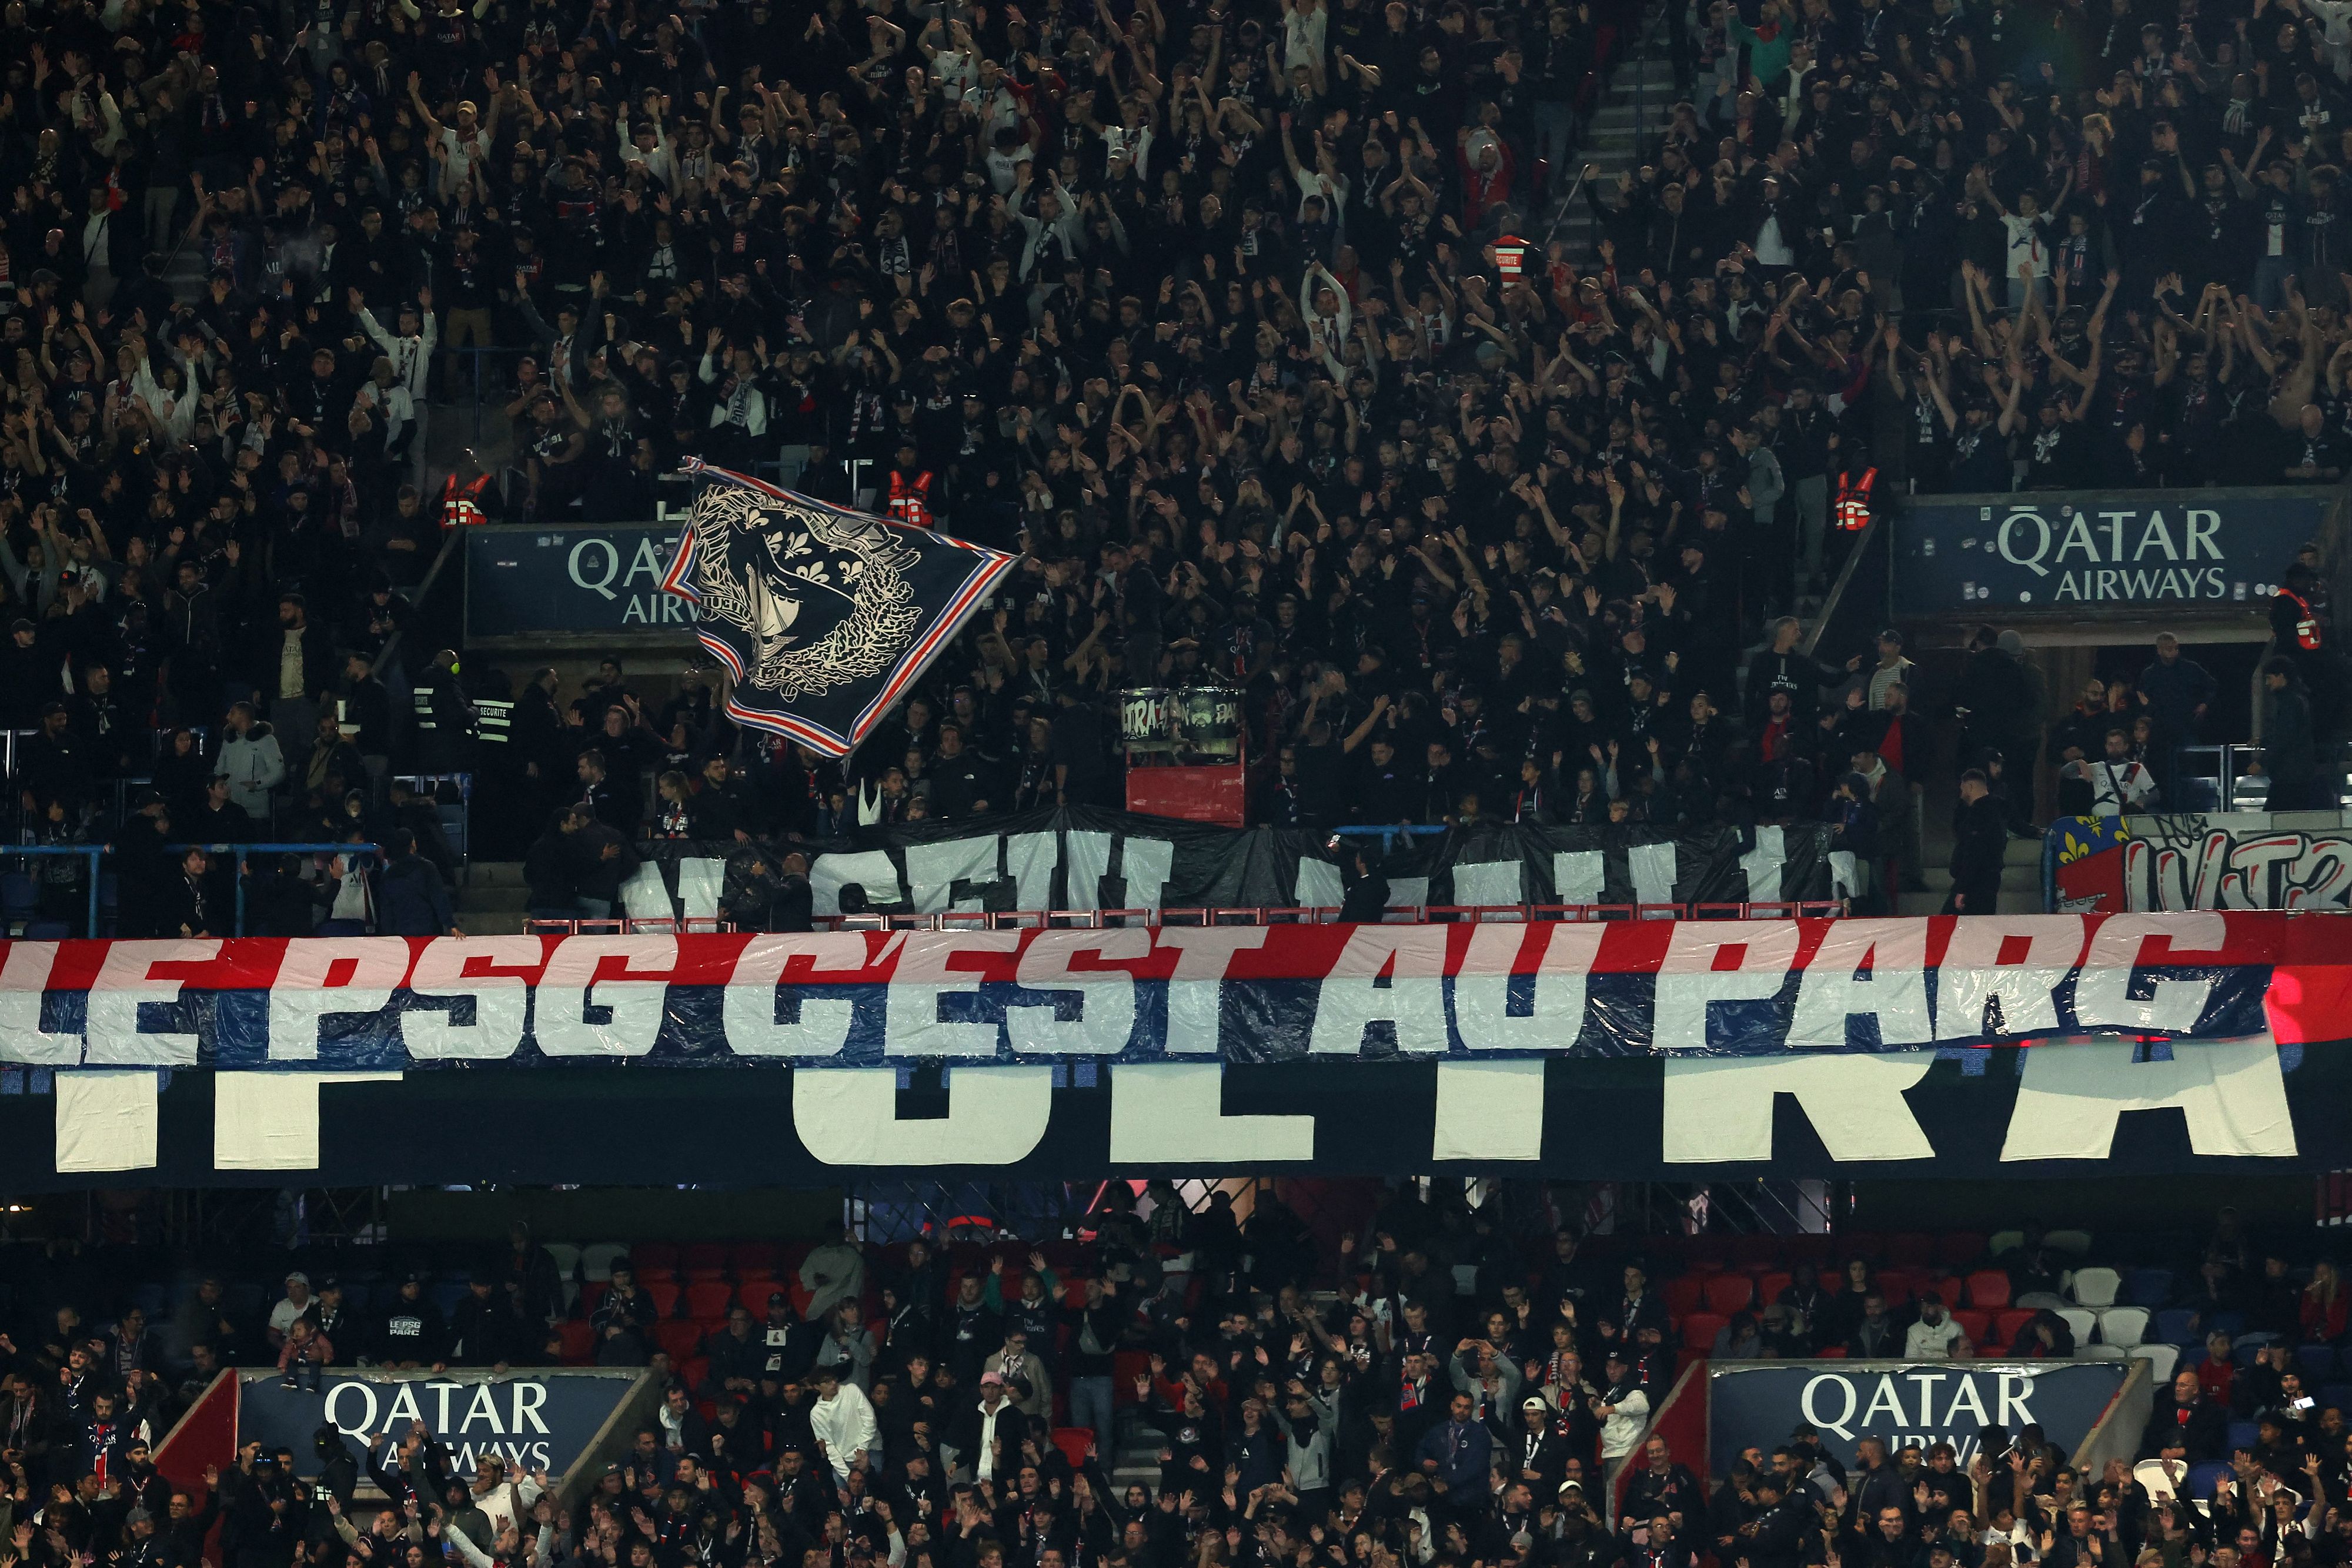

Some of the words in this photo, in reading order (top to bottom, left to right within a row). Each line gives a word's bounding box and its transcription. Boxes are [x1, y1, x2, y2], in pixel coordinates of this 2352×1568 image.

[1997, 510, 2225, 577] QATAR
[2054, 567, 2226, 601] AIRWAYS
[480, 707, 507, 718] SECURITE
[0, 937, 225, 1067] LE
[266, 932, 679, 1061] PSG
[722, 925, 1269, 1058] C'EST
[1308, 921, 1610, 1055] AU
[1652, 911, 2227, 1049] PARC
[324, 1381, 551, 1448] QATAR
[1800, 1373, 2037, 1442] QATAR
